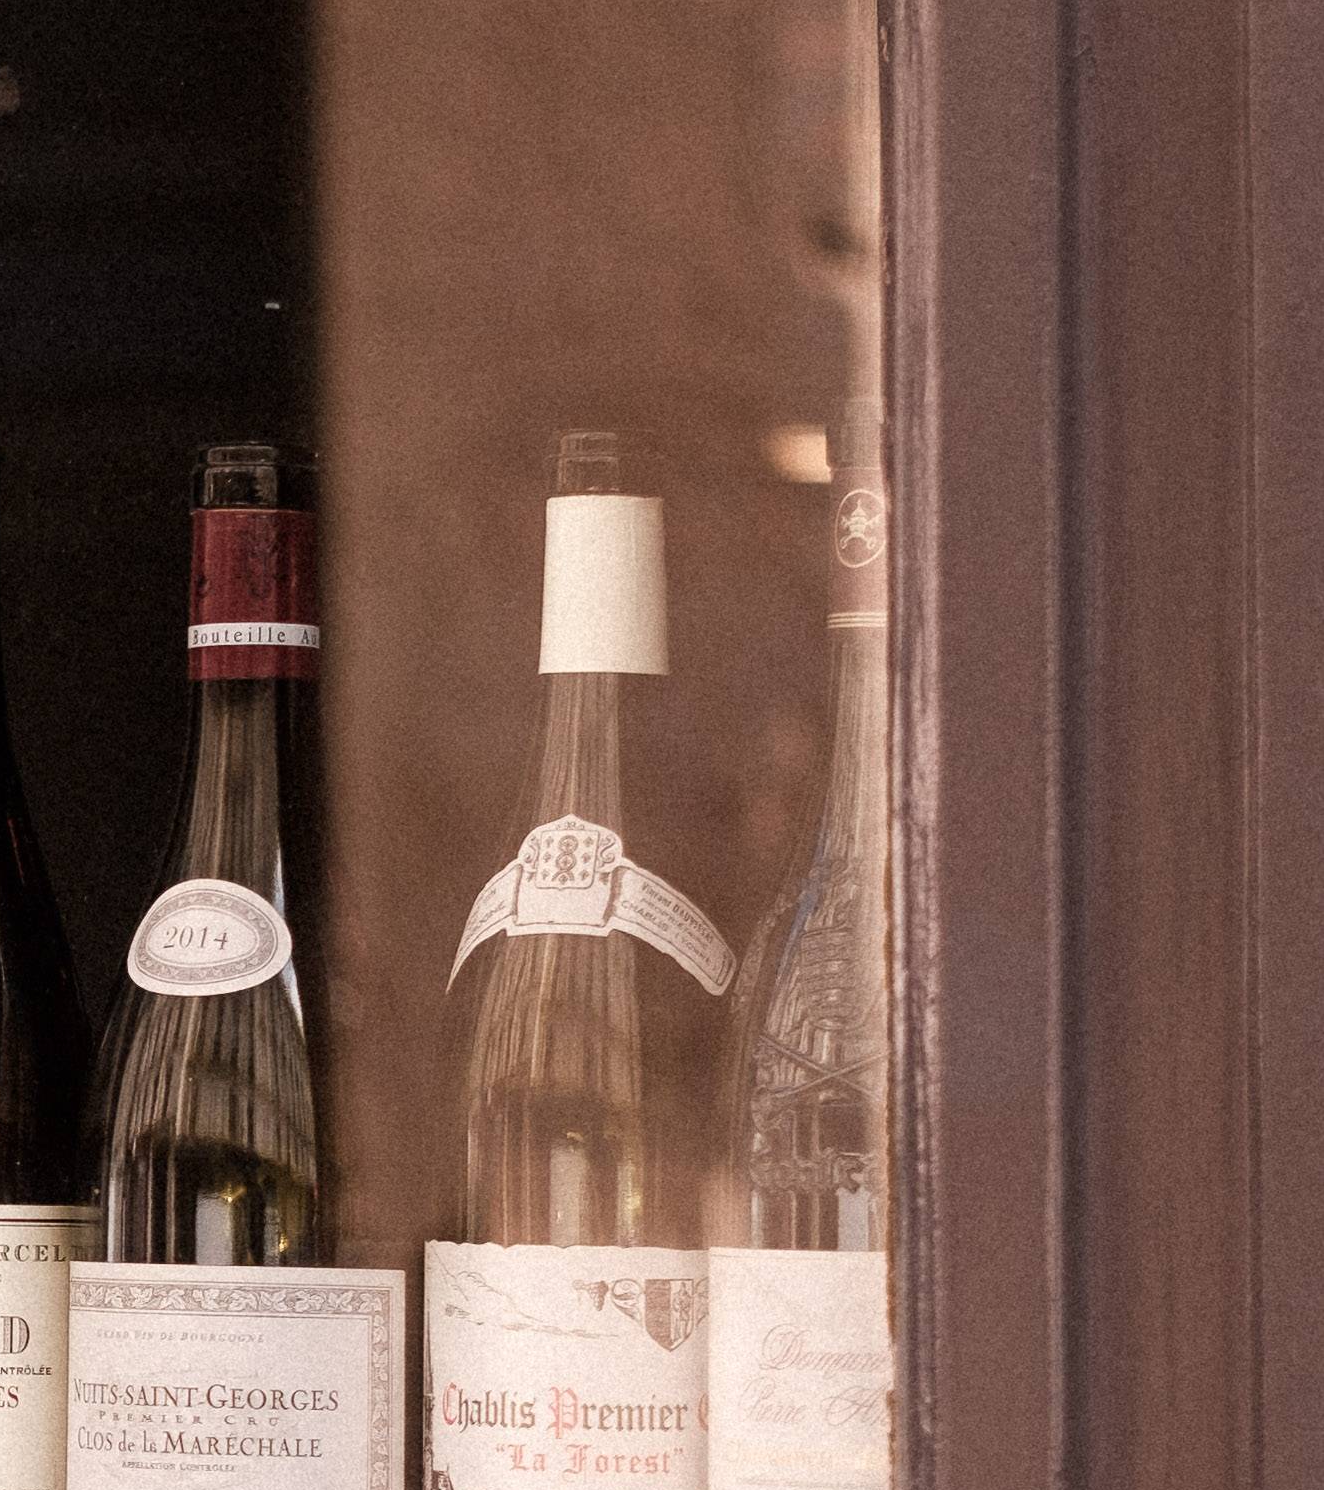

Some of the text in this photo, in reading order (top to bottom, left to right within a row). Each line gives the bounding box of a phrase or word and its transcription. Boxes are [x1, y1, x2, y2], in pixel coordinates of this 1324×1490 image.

[192, 627, 318, 646] Bouteille Au
[163, 925, 229, 950] 2014
[73, 1378, 340, 1411] NUITS-SAINT-GEORGES
[99, 1410, 280, 1427] PREMIER CRU
[442, 1381, 536, 1434] Chablis
[547, 1386, 688, 1440] Premier
[77, 1426, 113, 1451] CLOS
[118, 1429, 136, 1453] de
[162, 1430, 323, 1458] MARÉCHALE
